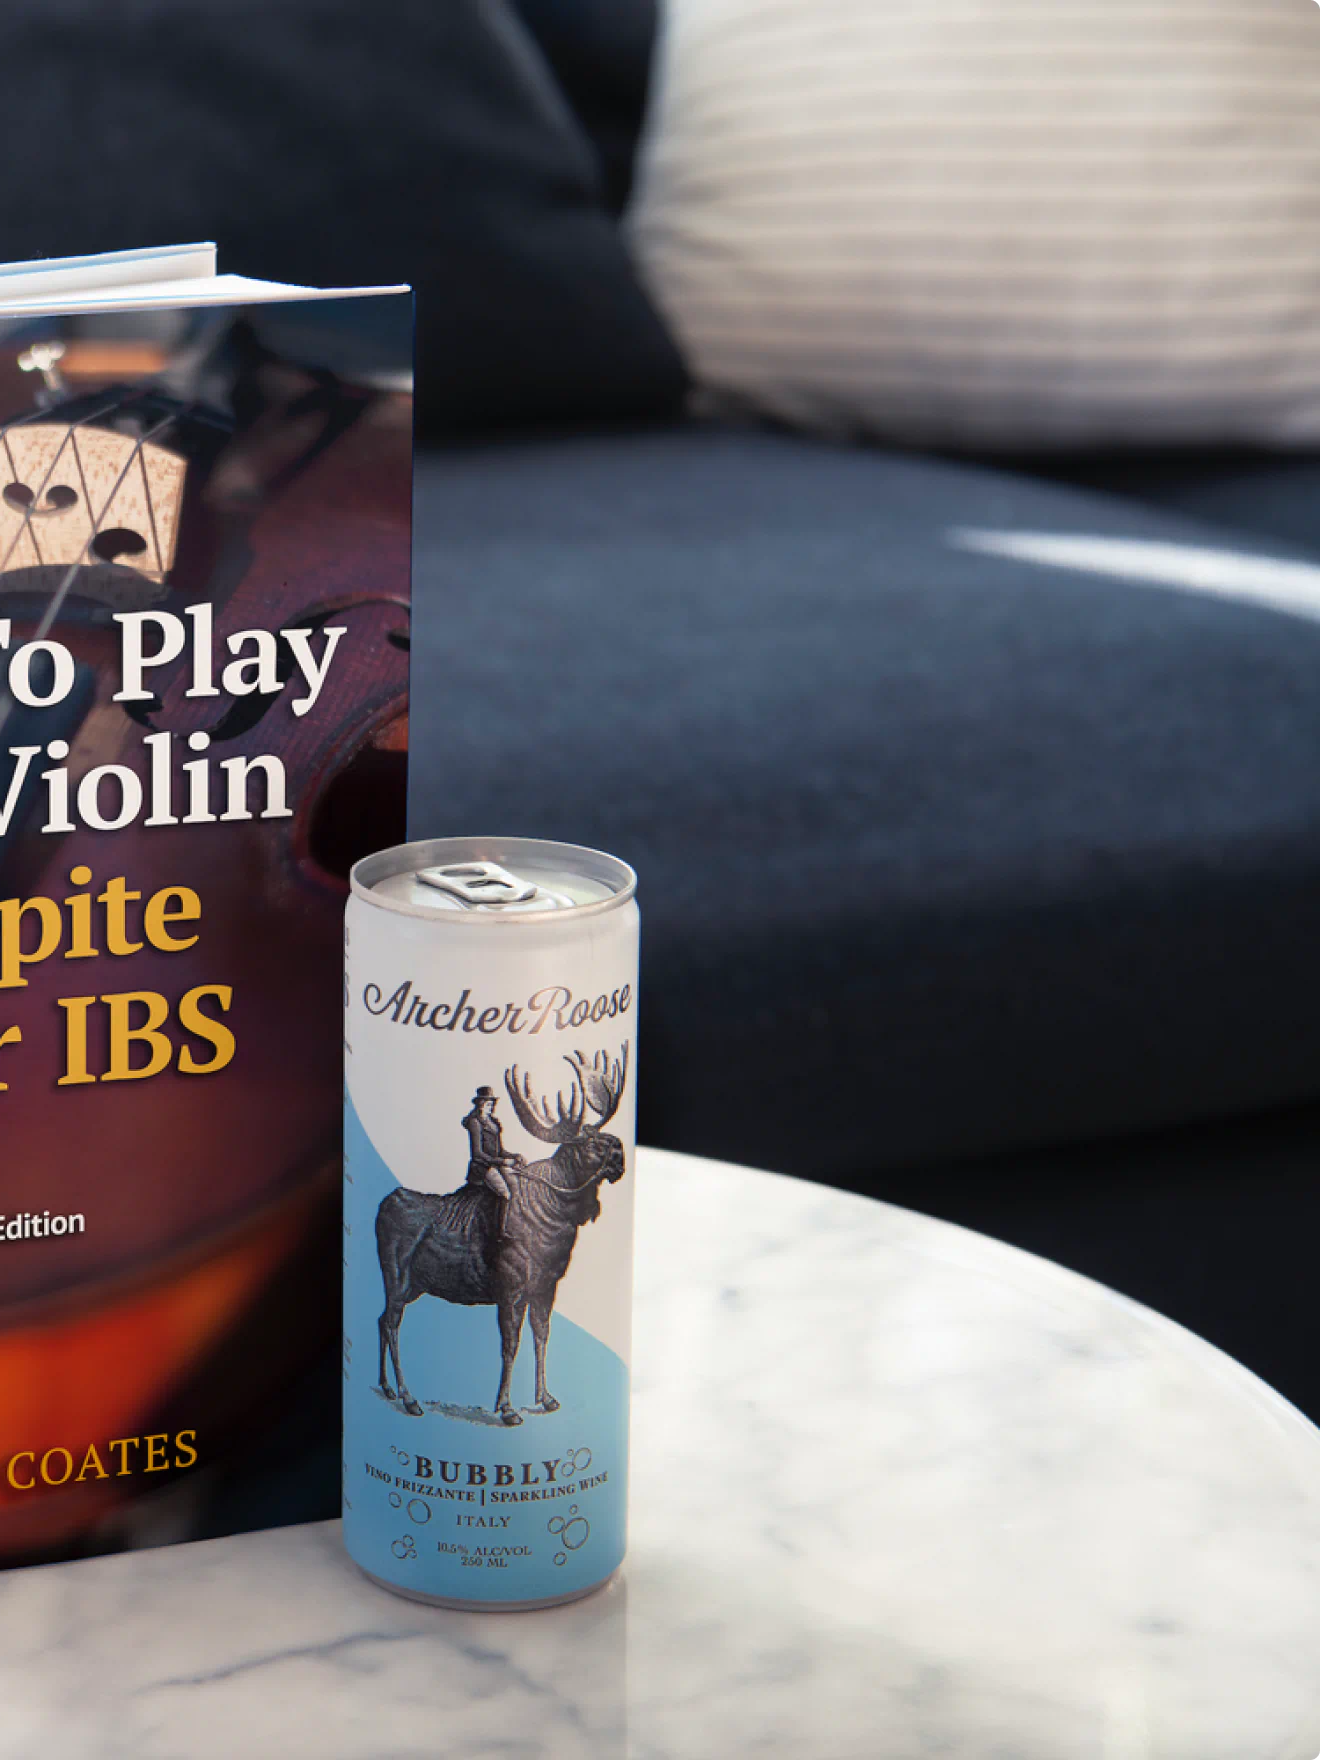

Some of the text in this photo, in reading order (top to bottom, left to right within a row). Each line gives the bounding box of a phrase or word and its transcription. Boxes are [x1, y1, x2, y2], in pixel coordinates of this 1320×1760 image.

[113, 603, 347, 715] Play
[364, 981, 631, 1034] Archer Roose
[57, 984, 236, 1086] IBS
[7, 1430, 198, 1489] COATES
[365, 1463, 608, 1502] VINO FRIZZANTE SPARKLING WINE
[414, 1455, 561, 1486] BUBBLY
[456, 1514, 511, 1528] ITALY
[460, 1556, 508, 1568] 250 ML
